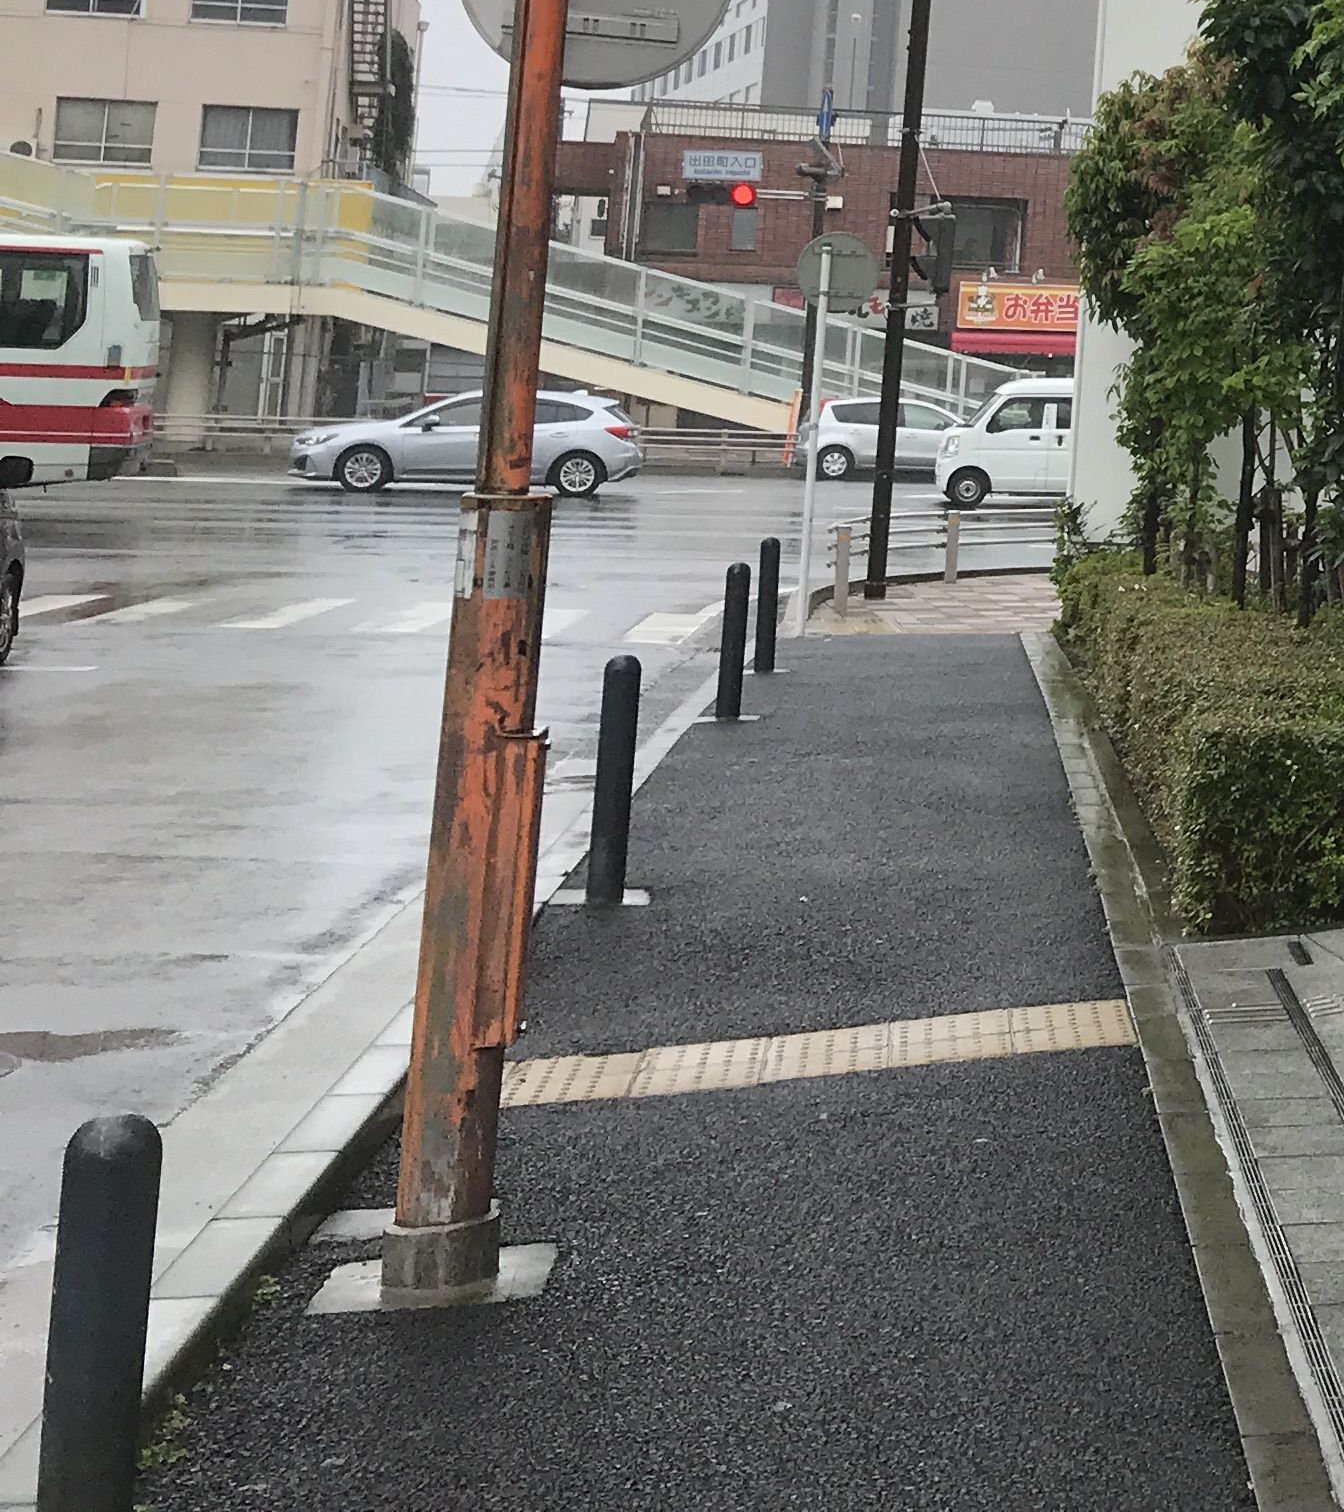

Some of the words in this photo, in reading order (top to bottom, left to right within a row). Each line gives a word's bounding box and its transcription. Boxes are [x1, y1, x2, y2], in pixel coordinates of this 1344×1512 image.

[688, 154, 757, 169] 出田町入口
[1003, 292, 1080, 324] お弁当
